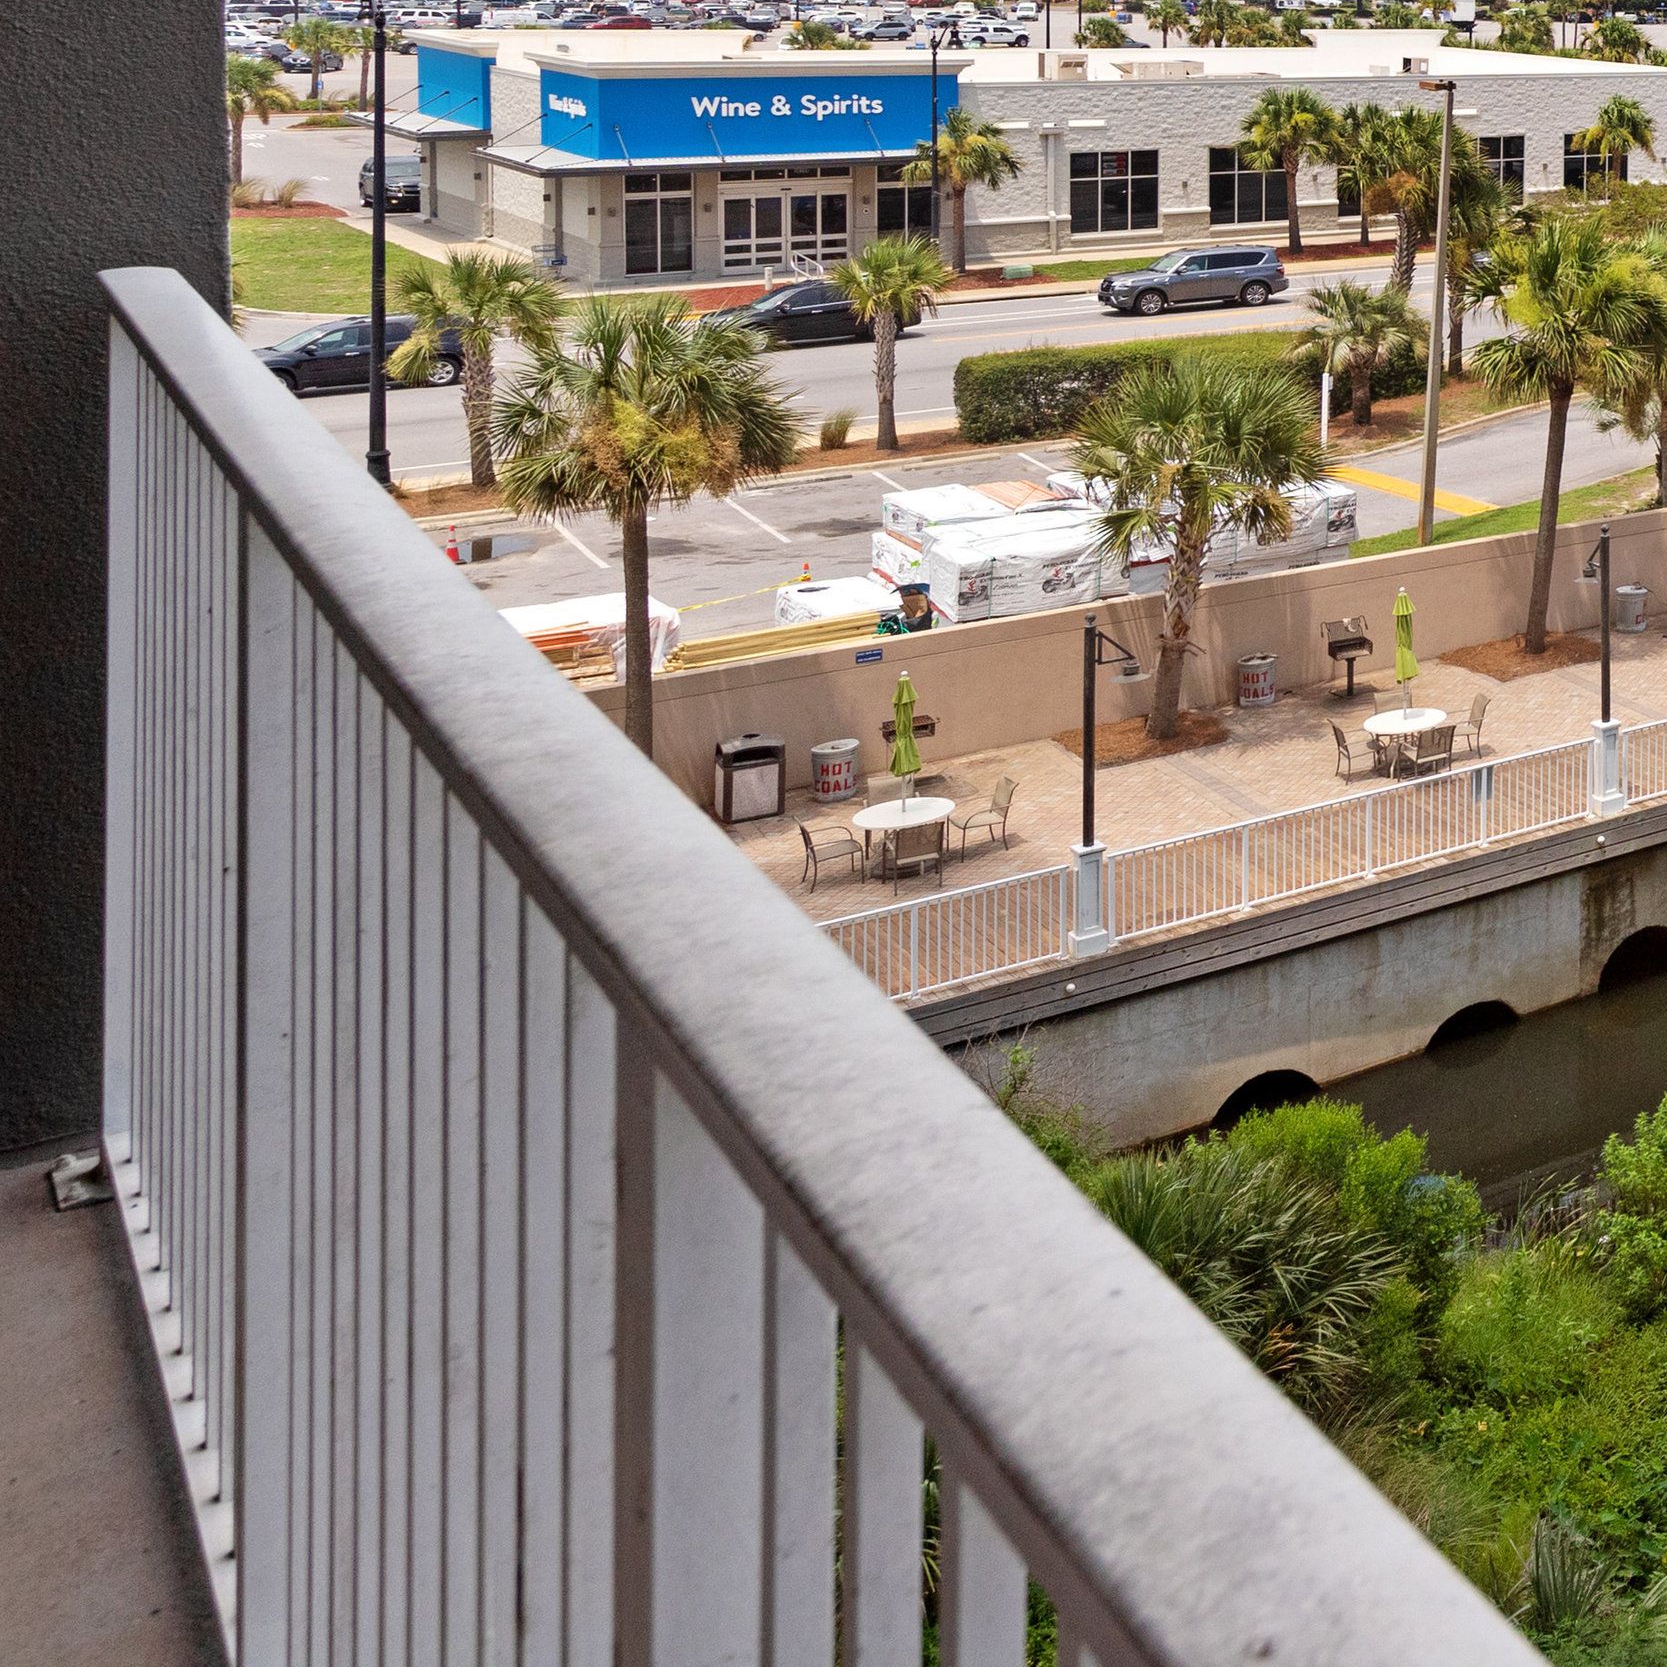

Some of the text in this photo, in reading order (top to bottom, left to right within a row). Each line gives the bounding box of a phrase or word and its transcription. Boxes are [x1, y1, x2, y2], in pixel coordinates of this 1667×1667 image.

[691, 94, 884, 121] Wine & Spirits
[1243, 670, 1268, 684] HOT
[820, 761, 852, 777] HOT
[815, 774, 857, 793] COALS
